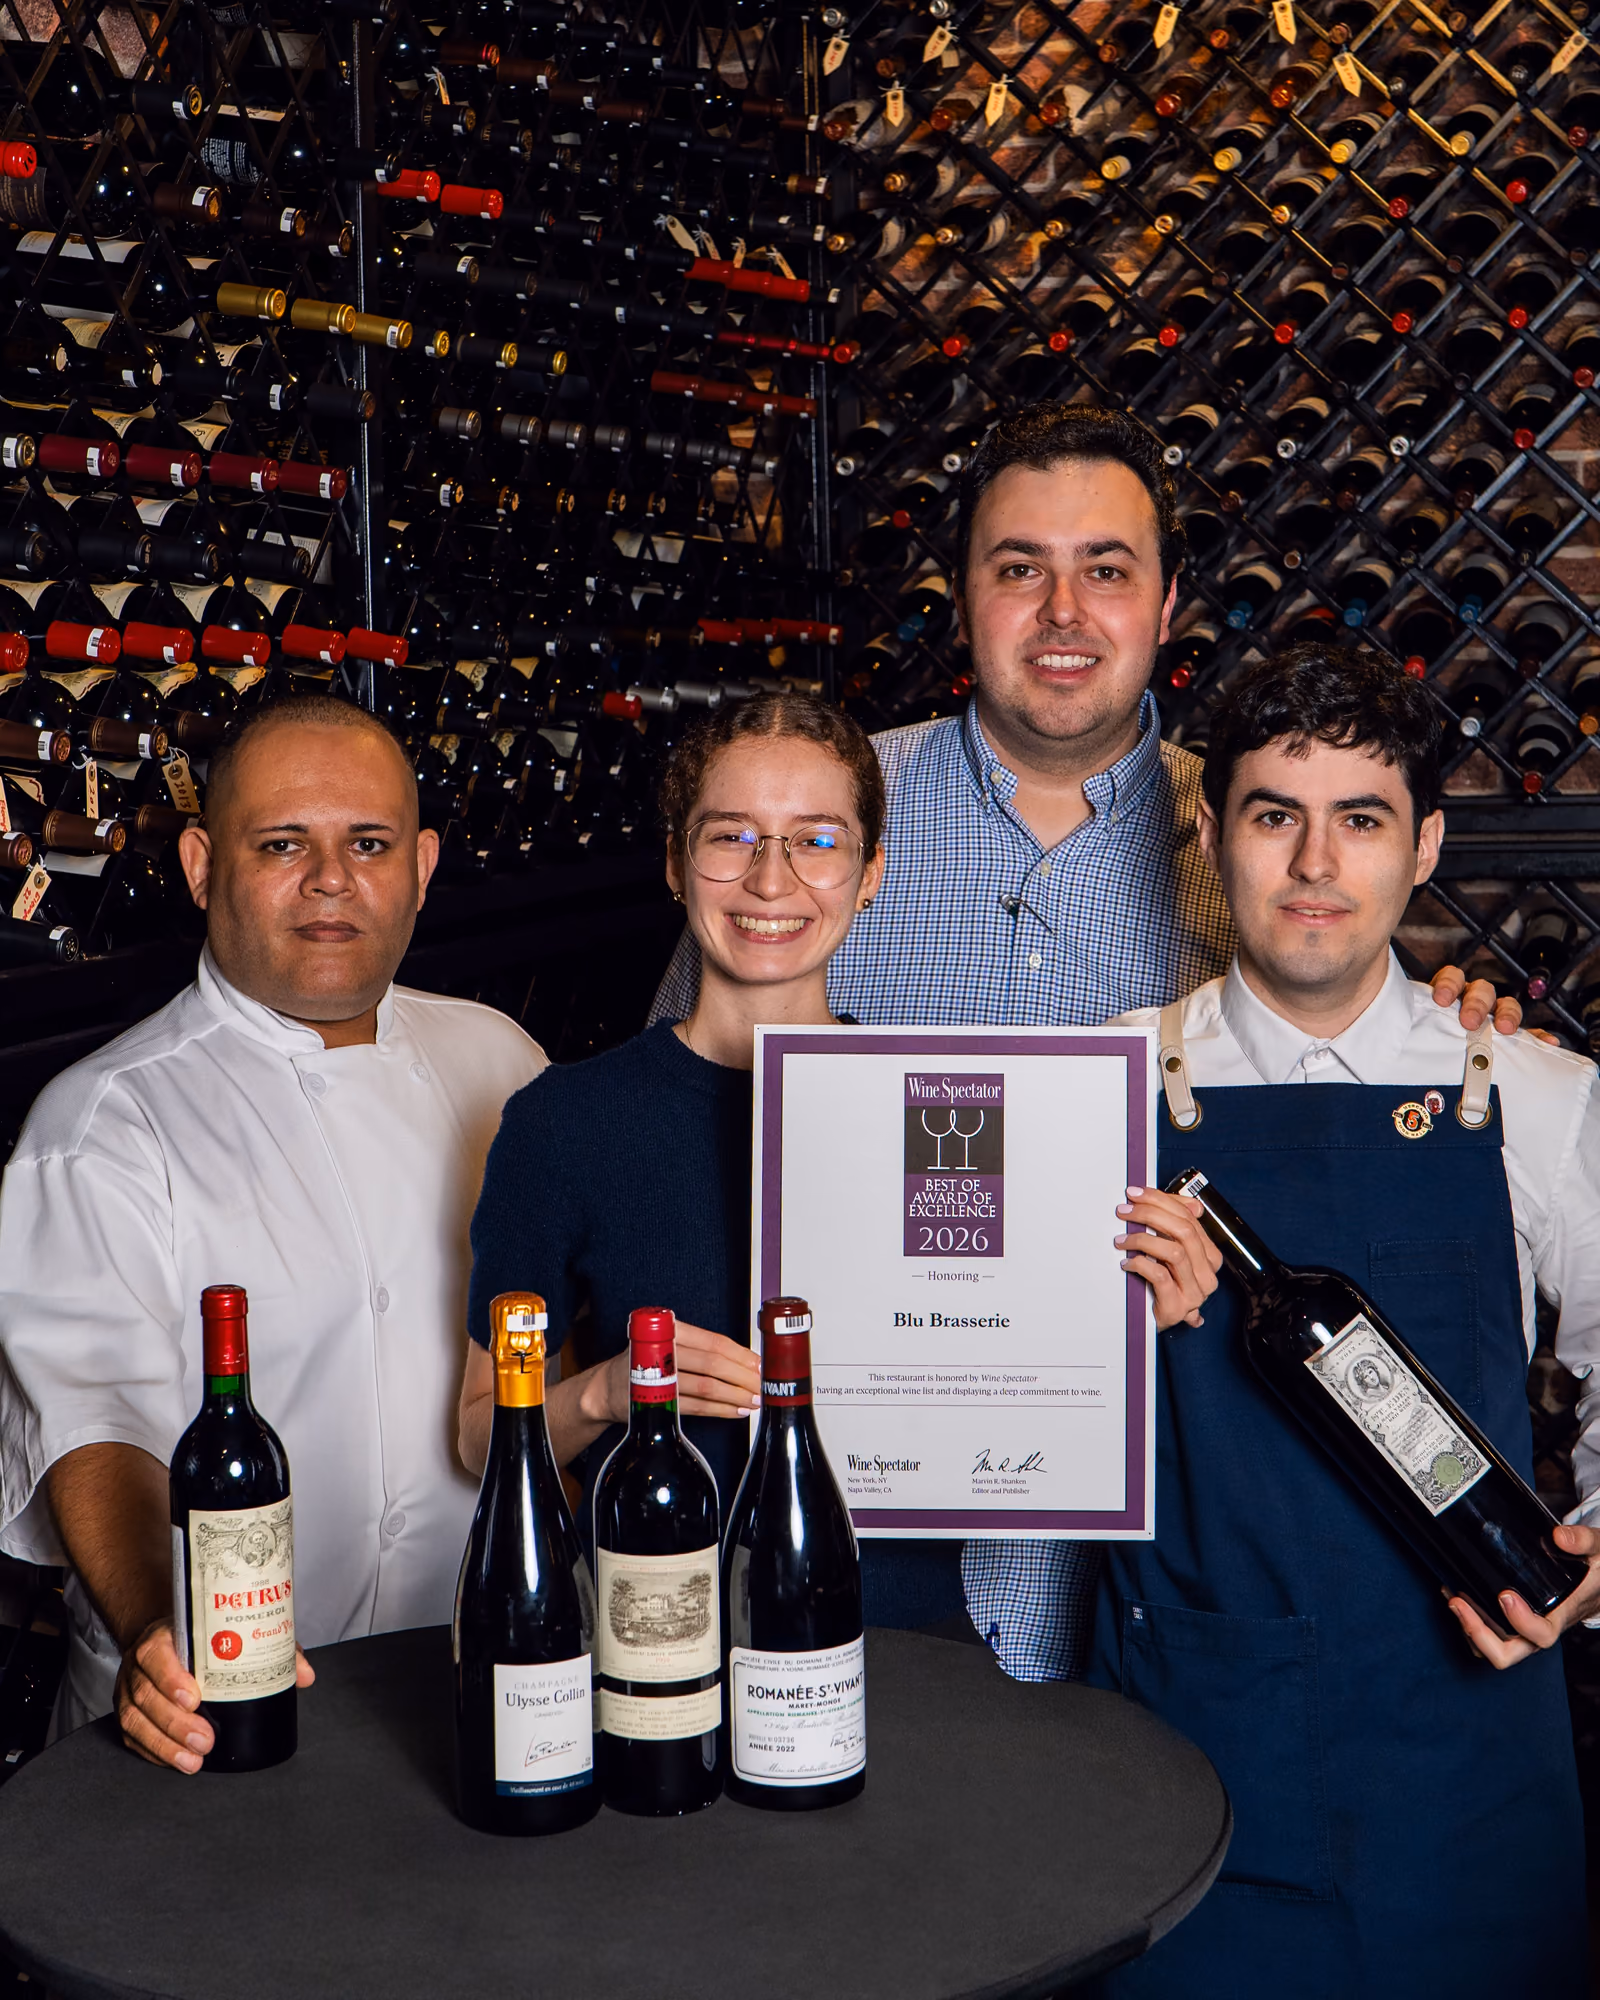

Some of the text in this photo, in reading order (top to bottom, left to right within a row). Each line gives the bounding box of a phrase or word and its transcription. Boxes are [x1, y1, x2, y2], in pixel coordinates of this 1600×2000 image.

[89, 786, 97, 818] 201
[174, 782, 192, 808] 2013
[908, 1076, 1002, 1104] Wine Spectator
[1408, 1110, 1420, 1130] 5
[925, 1178, 981, 1192] BEST OF
[911, 1191, 992, 1205] AWARD OF
[908, 1204, 996, 1218] EXCELLENCE
[918, 1226, 989, 1252] 2026
[928, 1270, 980, 1283] Honoring
[893, 1312, 1011, 1328] Blu Brasserie
[868, 1373, 1039, 1384] This restaurant is honored by Wine Spectator
[816, 1385, 1102, 1398] having an exceptional wine list and displaying a deep commitment to wine.
[847, 1454, 921, 1476] Wine Spectator
[847, 1486, 863, 1494] Napa
[883, 1486, 892, 1494] CA
[1002, 1487, 1030, 1495] Publisher
[225, 1607, 287, 1623] POMEROL
[251, 1622, 282, 1641] Grand
[796, 1657, 823, 1665] DOMAINE
[514, 1675, 579, 1690] CHAMPAGNE
[506, 1692, 550, 1710] Ulysse
[553, 1688, 586, 1704] Collin
[748, 1740, 796, 1753] ANNÉE 2022
